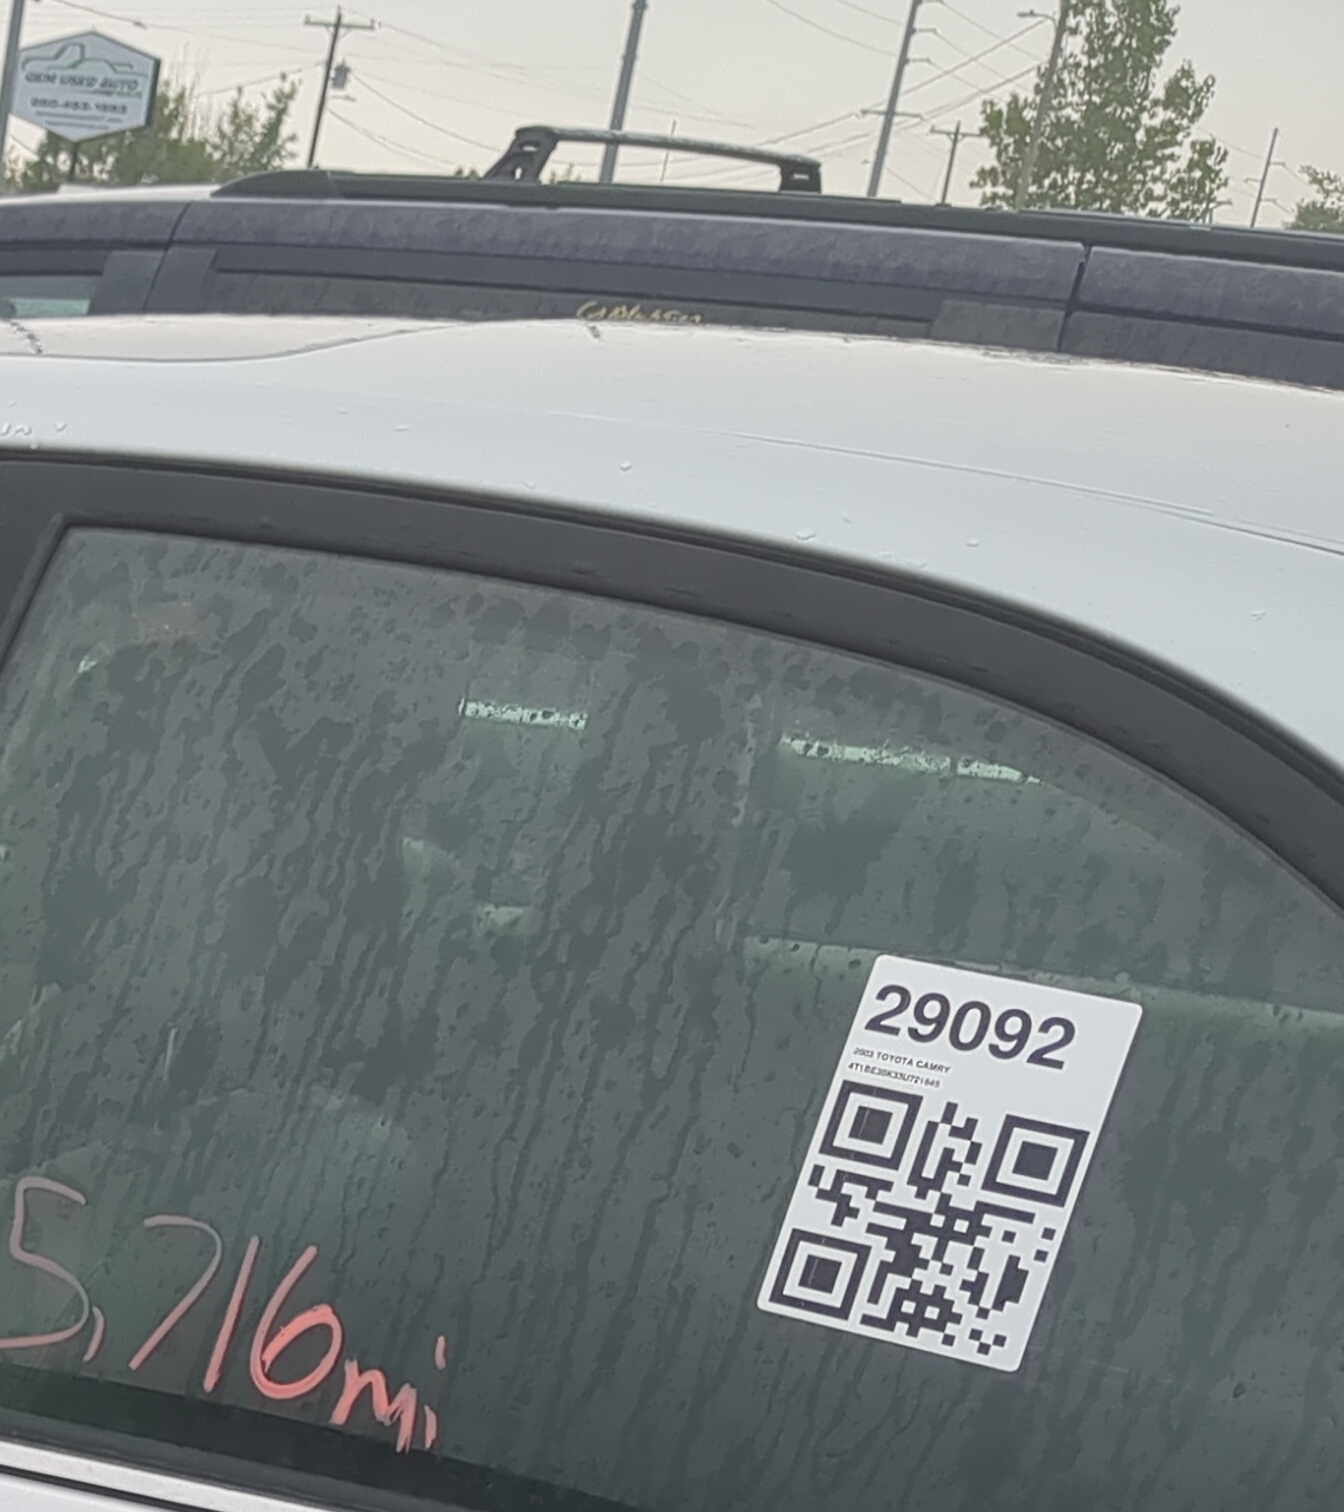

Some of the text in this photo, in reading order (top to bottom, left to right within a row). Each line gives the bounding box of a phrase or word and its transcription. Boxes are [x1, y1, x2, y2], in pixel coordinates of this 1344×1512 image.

[864, 984, 1076, 1070] 29092
[876, 1051, 914, 1067] TOYOTA
[915, 1059, 952, 1074] CAMRY
